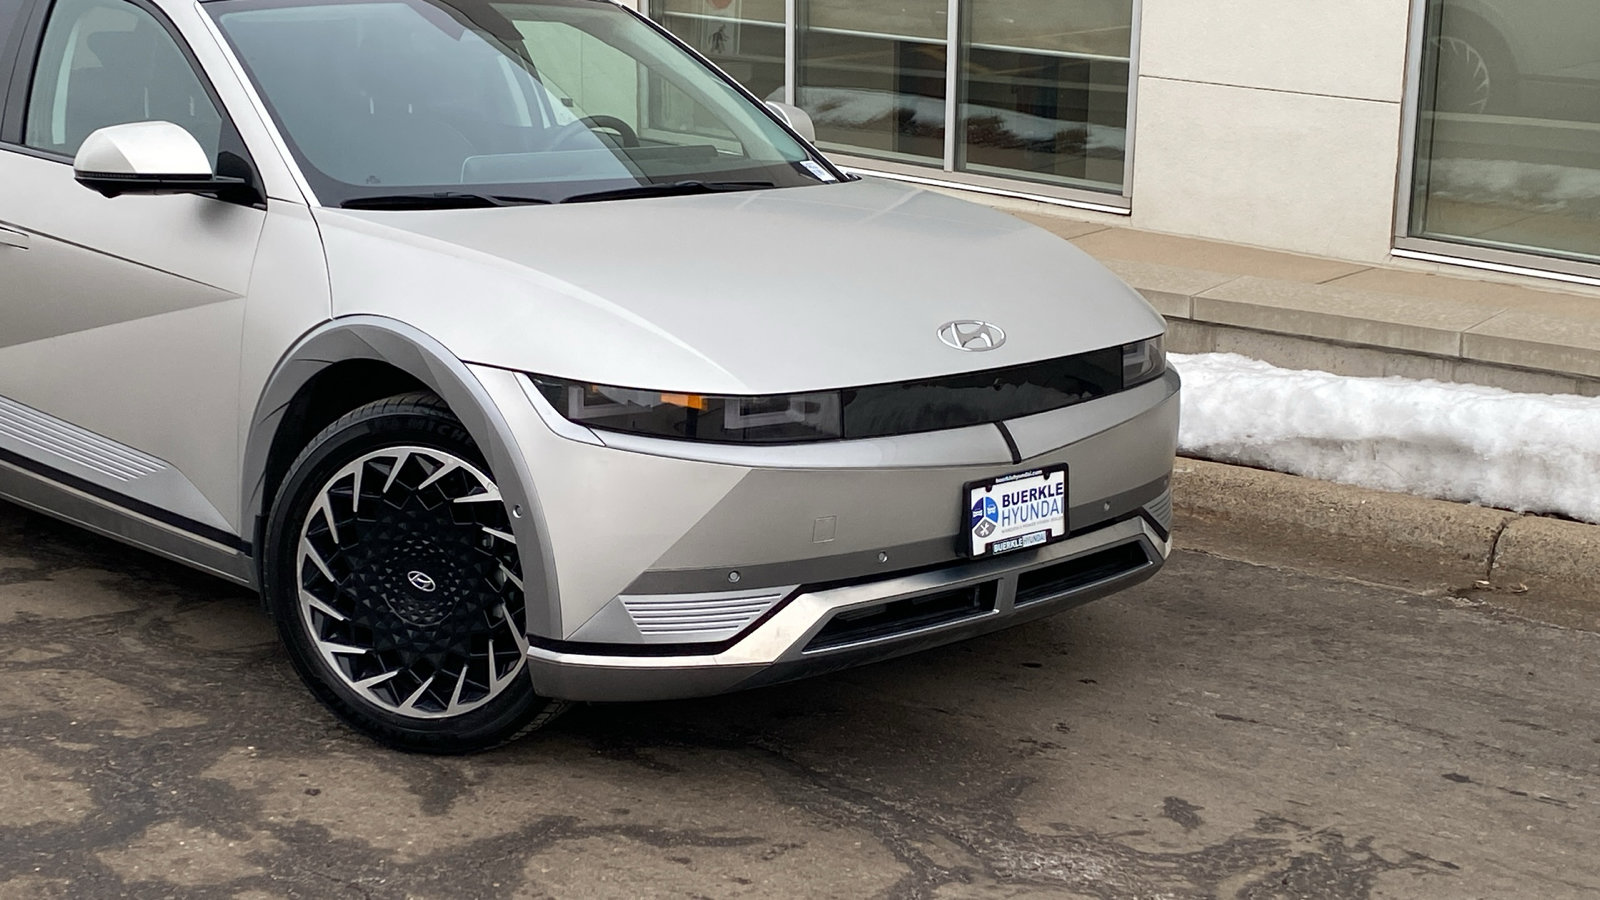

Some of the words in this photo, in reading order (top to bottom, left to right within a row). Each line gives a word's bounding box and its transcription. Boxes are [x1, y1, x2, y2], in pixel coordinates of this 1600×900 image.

[1002, 482, 1064, 508] BUERKLE
[1001, 497, 1064, 527] HYUNDAI
[993, 537, 1023, 553] BUERKLE
